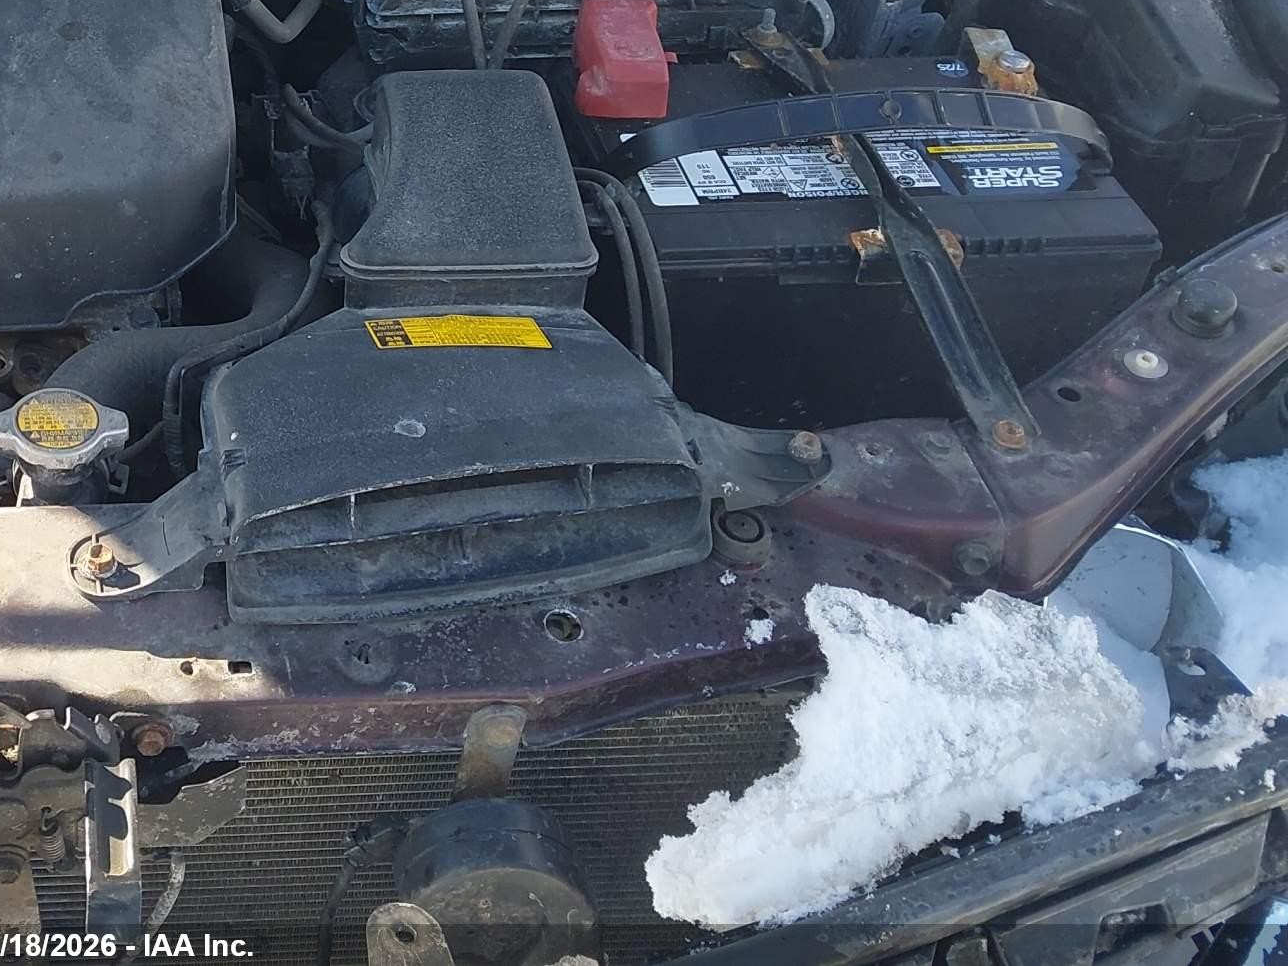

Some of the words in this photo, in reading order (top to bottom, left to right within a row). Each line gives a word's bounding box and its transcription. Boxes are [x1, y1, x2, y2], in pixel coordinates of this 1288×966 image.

[968, 165, 1063, 179] START
[973, 177, 1060, 188] SUPER
[787, 189, 869, 198] NGER/POISON
